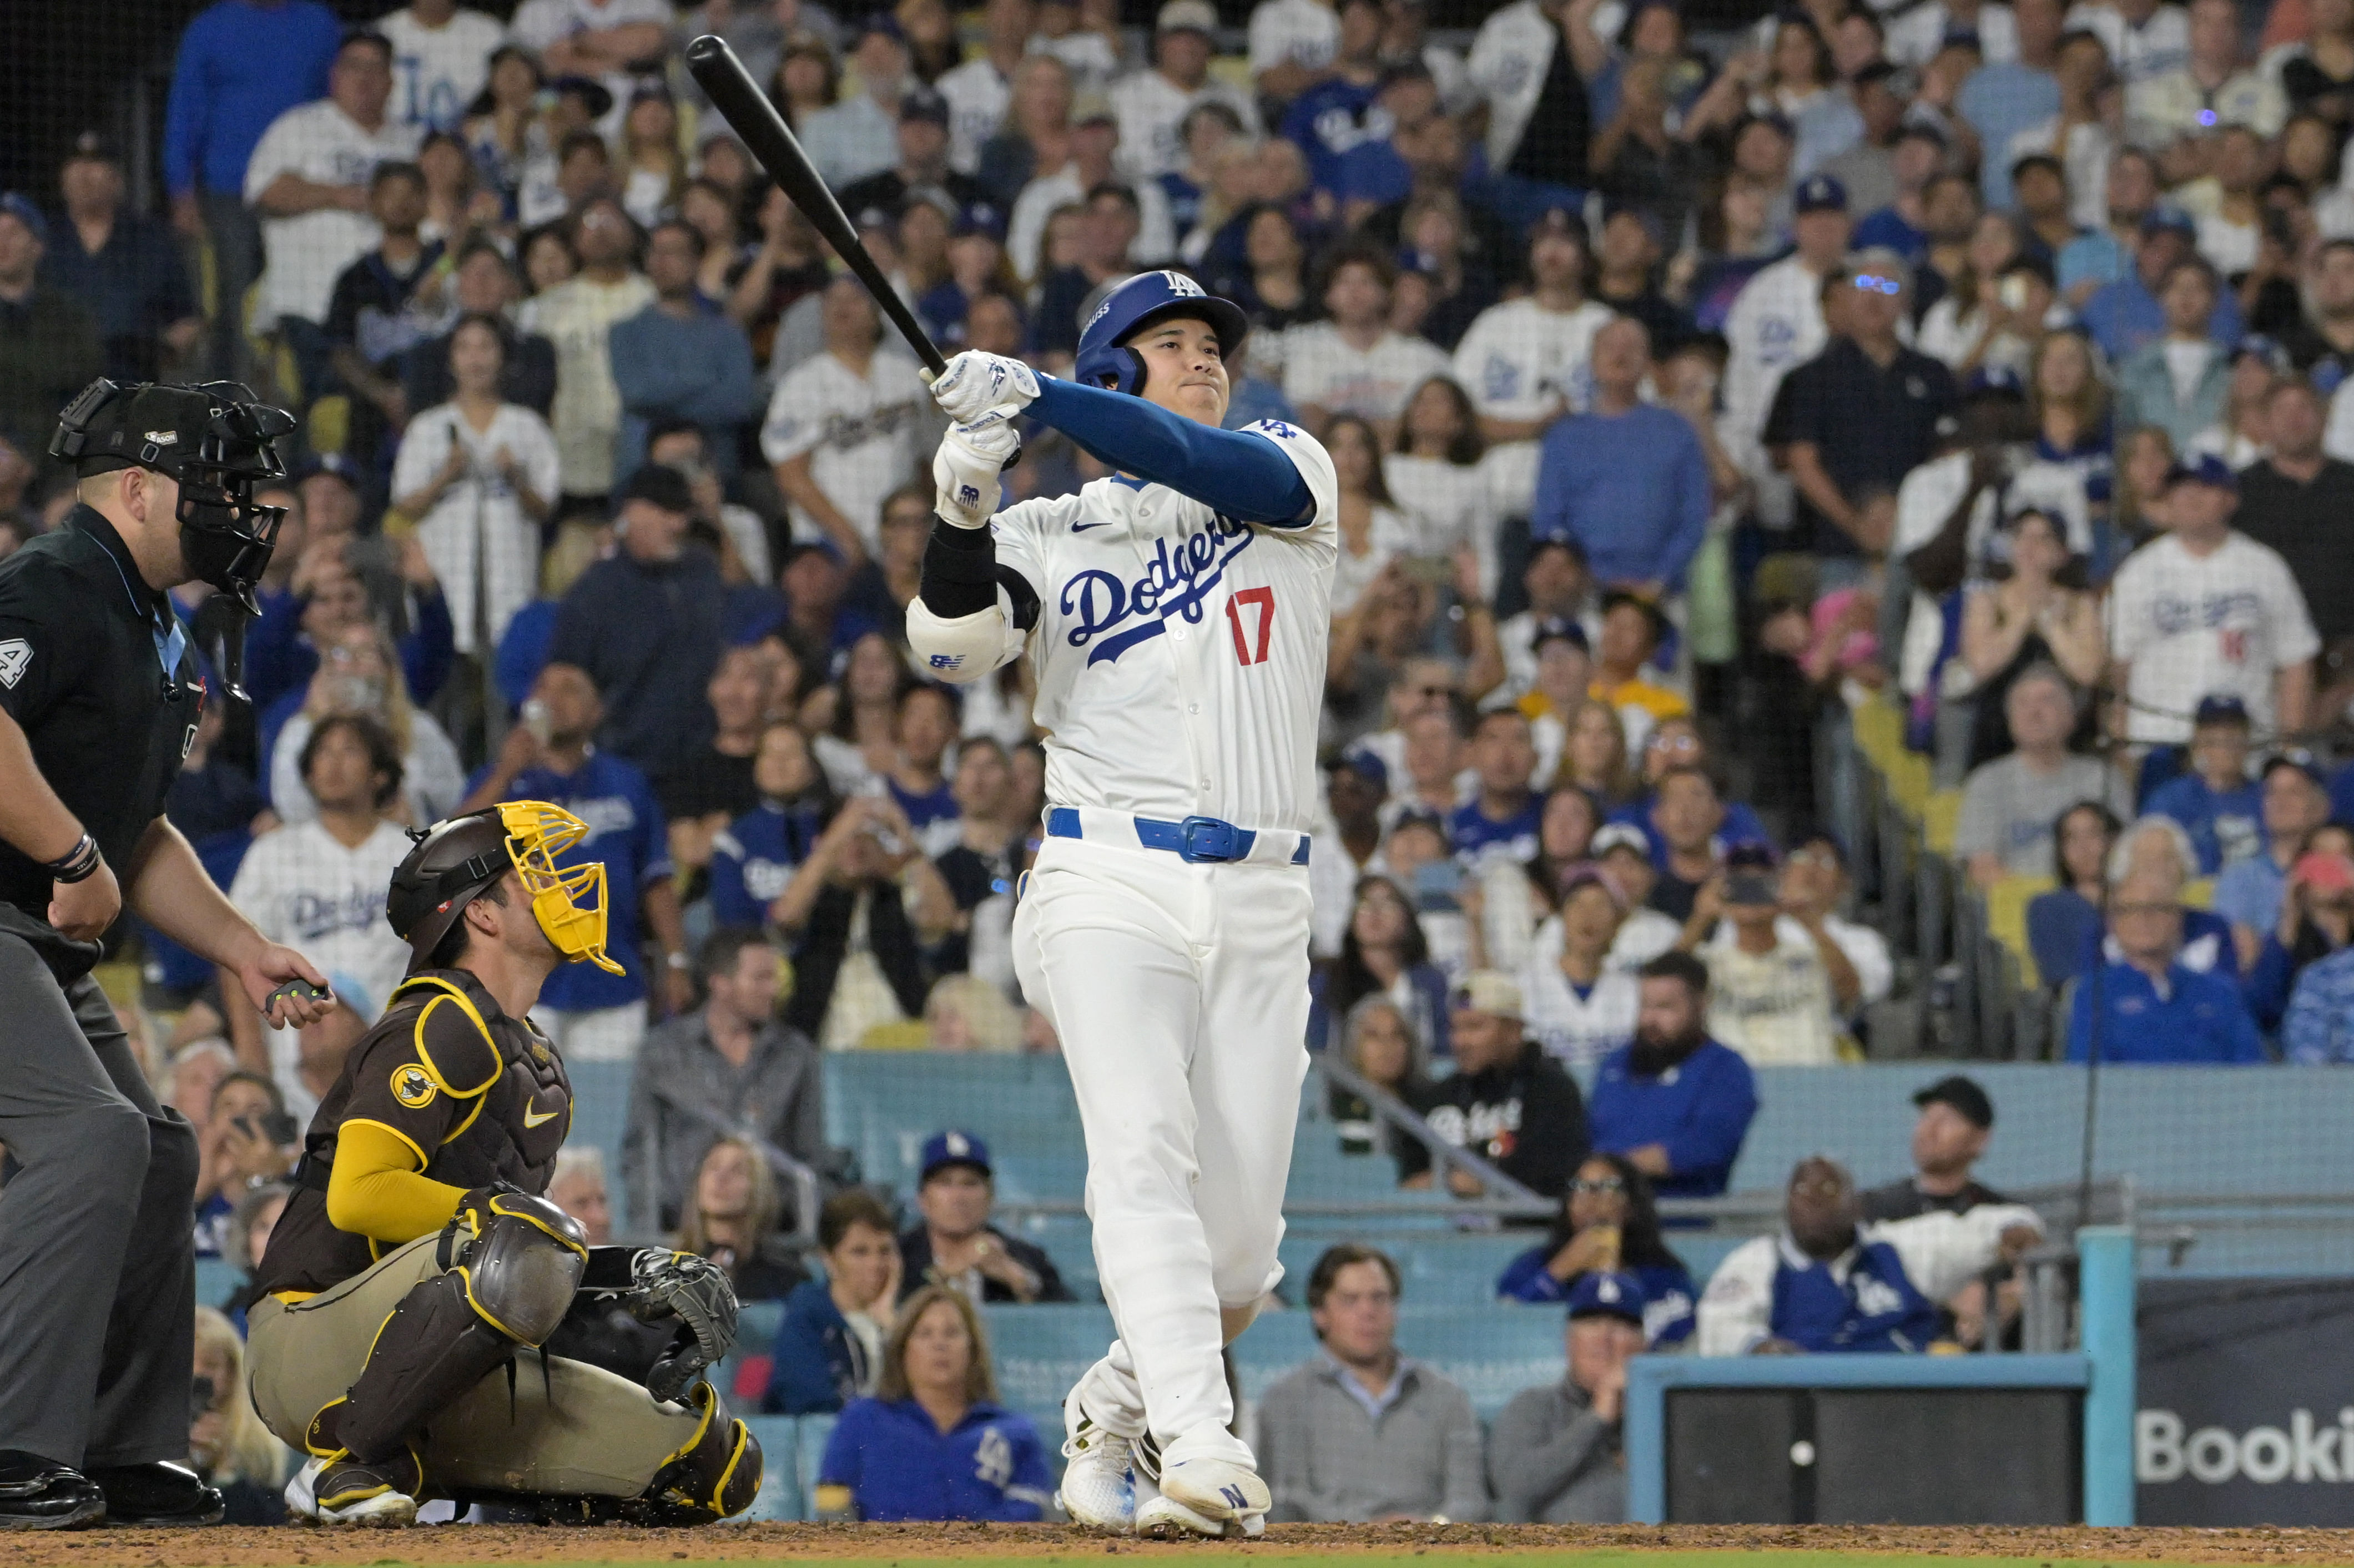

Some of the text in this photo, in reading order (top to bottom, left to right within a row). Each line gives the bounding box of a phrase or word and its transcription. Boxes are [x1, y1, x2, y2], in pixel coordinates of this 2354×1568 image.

[1160, 270, 1197, 296] LA
[969, 416, 995, 431] balance
[1225, 586, 1275, 666] 17
[1219, 1483, 1248, 1509] N
